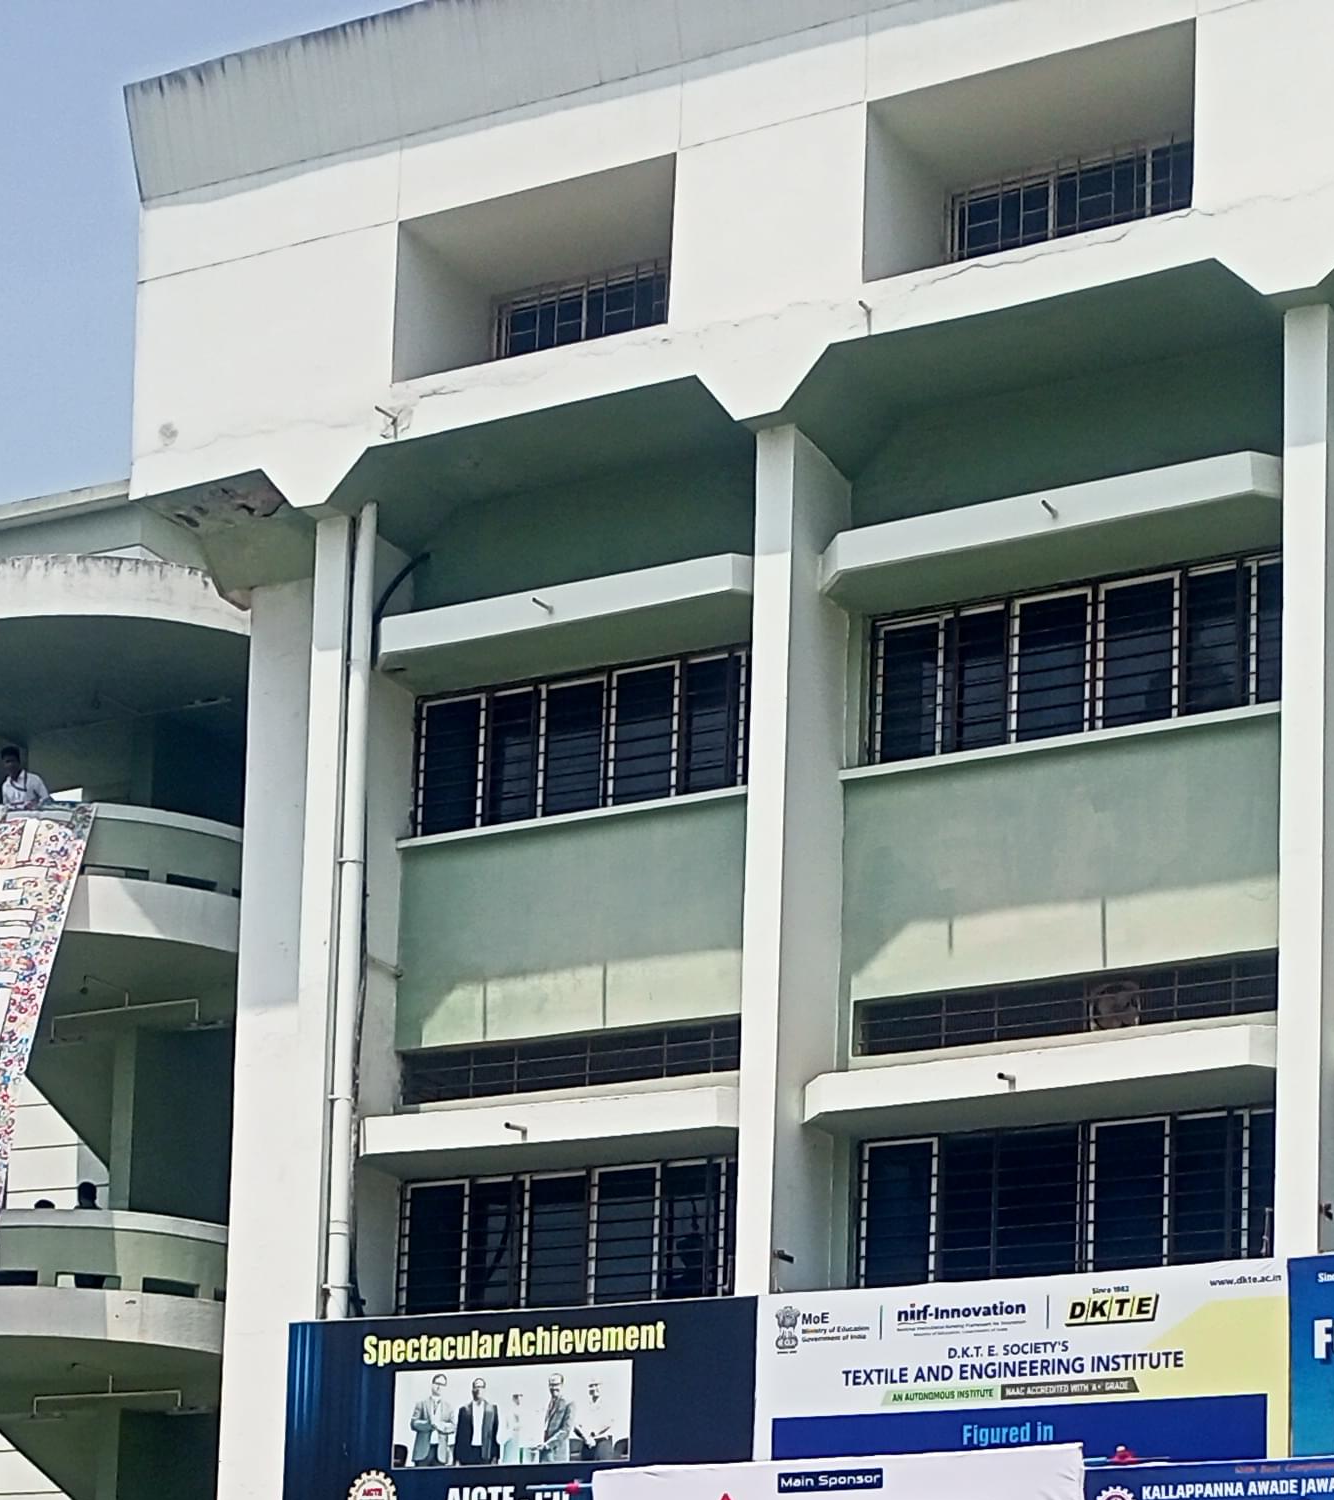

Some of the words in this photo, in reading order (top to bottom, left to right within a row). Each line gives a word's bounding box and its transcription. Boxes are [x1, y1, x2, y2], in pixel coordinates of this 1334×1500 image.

[802, 1312, 829, 1325] MoE
[364, 1328, 502, 1366] Spectacular
[506, 1321, 666, 1358] Achievement
[843, 1368, 908, 1386] TEXTILE
[914, 1365, 953, 1382] AND
[959, 1356, 1085, 1383] ENGINEERING
[1091, 1351, 1184, 1372] INSTITUTE
[892, 1393, 902, 1401] AN
[905, 1391, 955, 1400] AUTONOMOUS
[957, 1389, 993, 1398] INSTITUTE
[963, 1425, 1031, 1445] Figured
[1037, 1423, 1052, 1441] in
[781, 1476, 814, 1487] Main
[819, 1474, 881, 1487] Sponsor
[1142, 1481, 1244, 1500] KALLAPPANNA
[1248, 1479, 1297, 1495] AWADE
